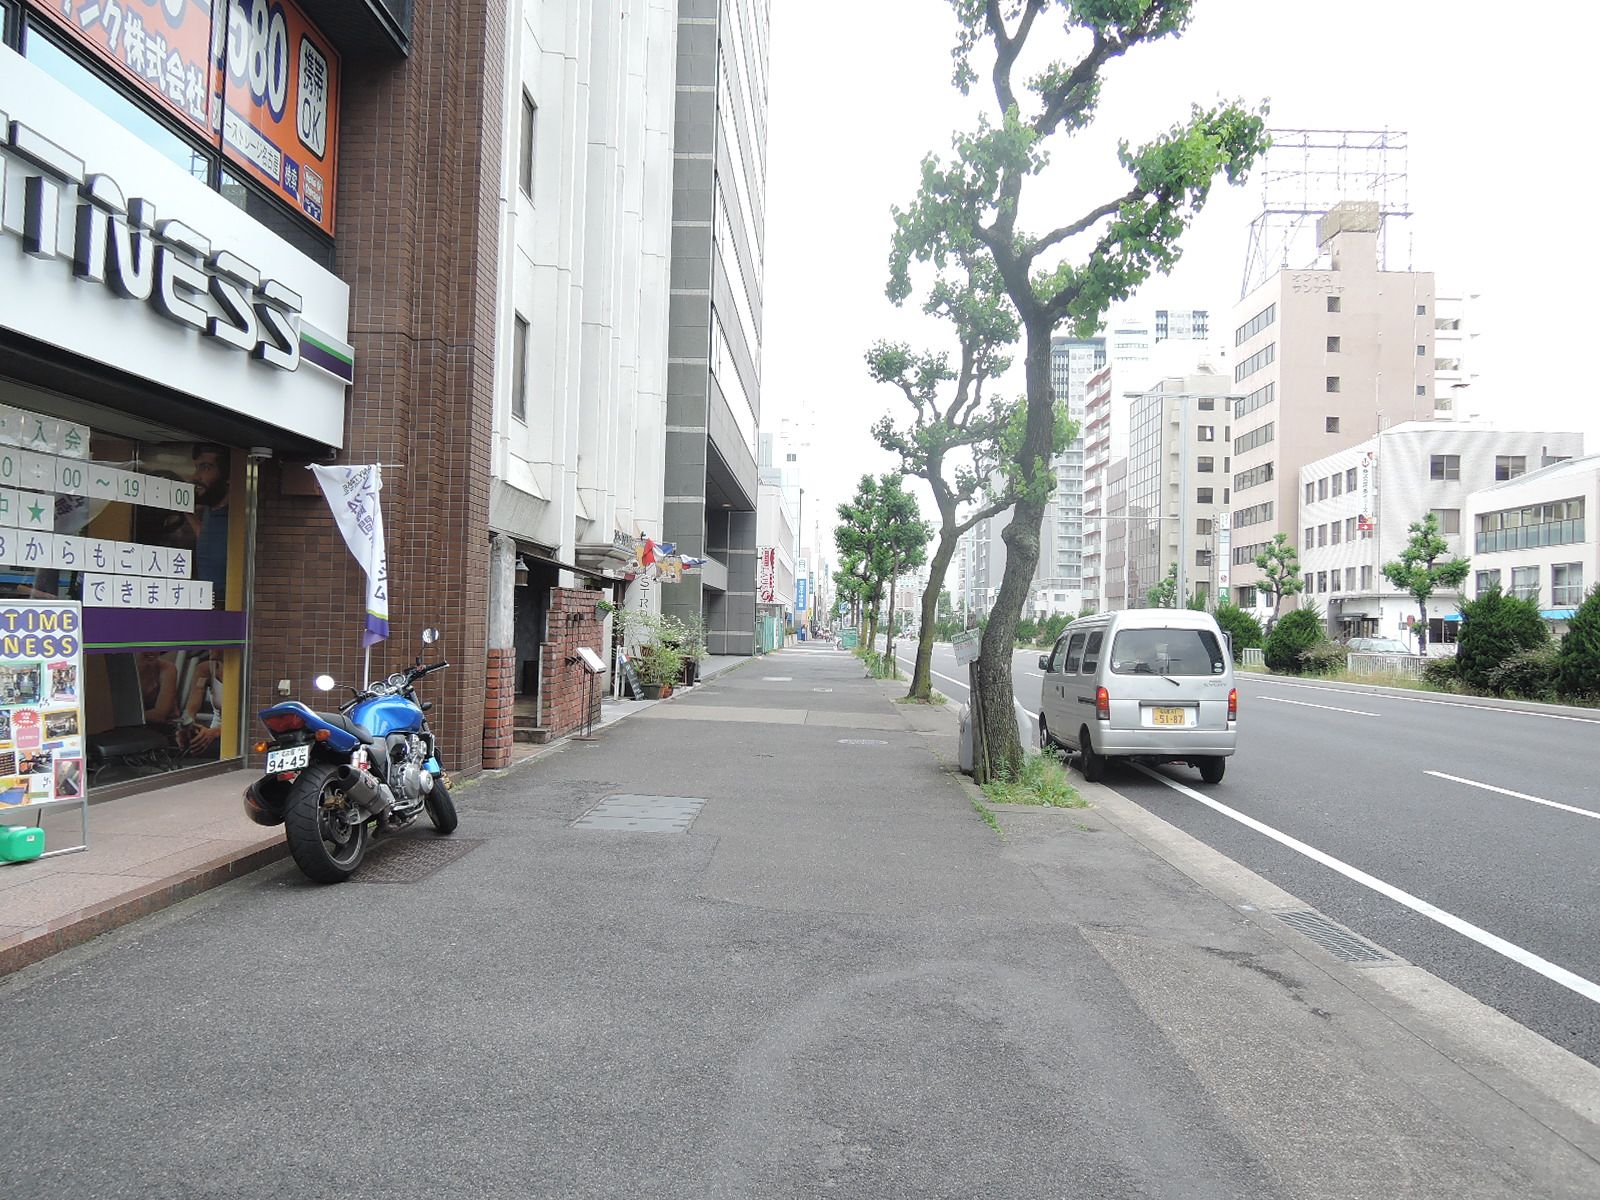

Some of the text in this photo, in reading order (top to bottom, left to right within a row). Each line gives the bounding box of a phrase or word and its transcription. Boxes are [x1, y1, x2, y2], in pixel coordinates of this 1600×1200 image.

[301, 97, 322, 151] OK
[1159, 715, 1183, 724] 51-87
[269, 754, 306, 772] 94-45
